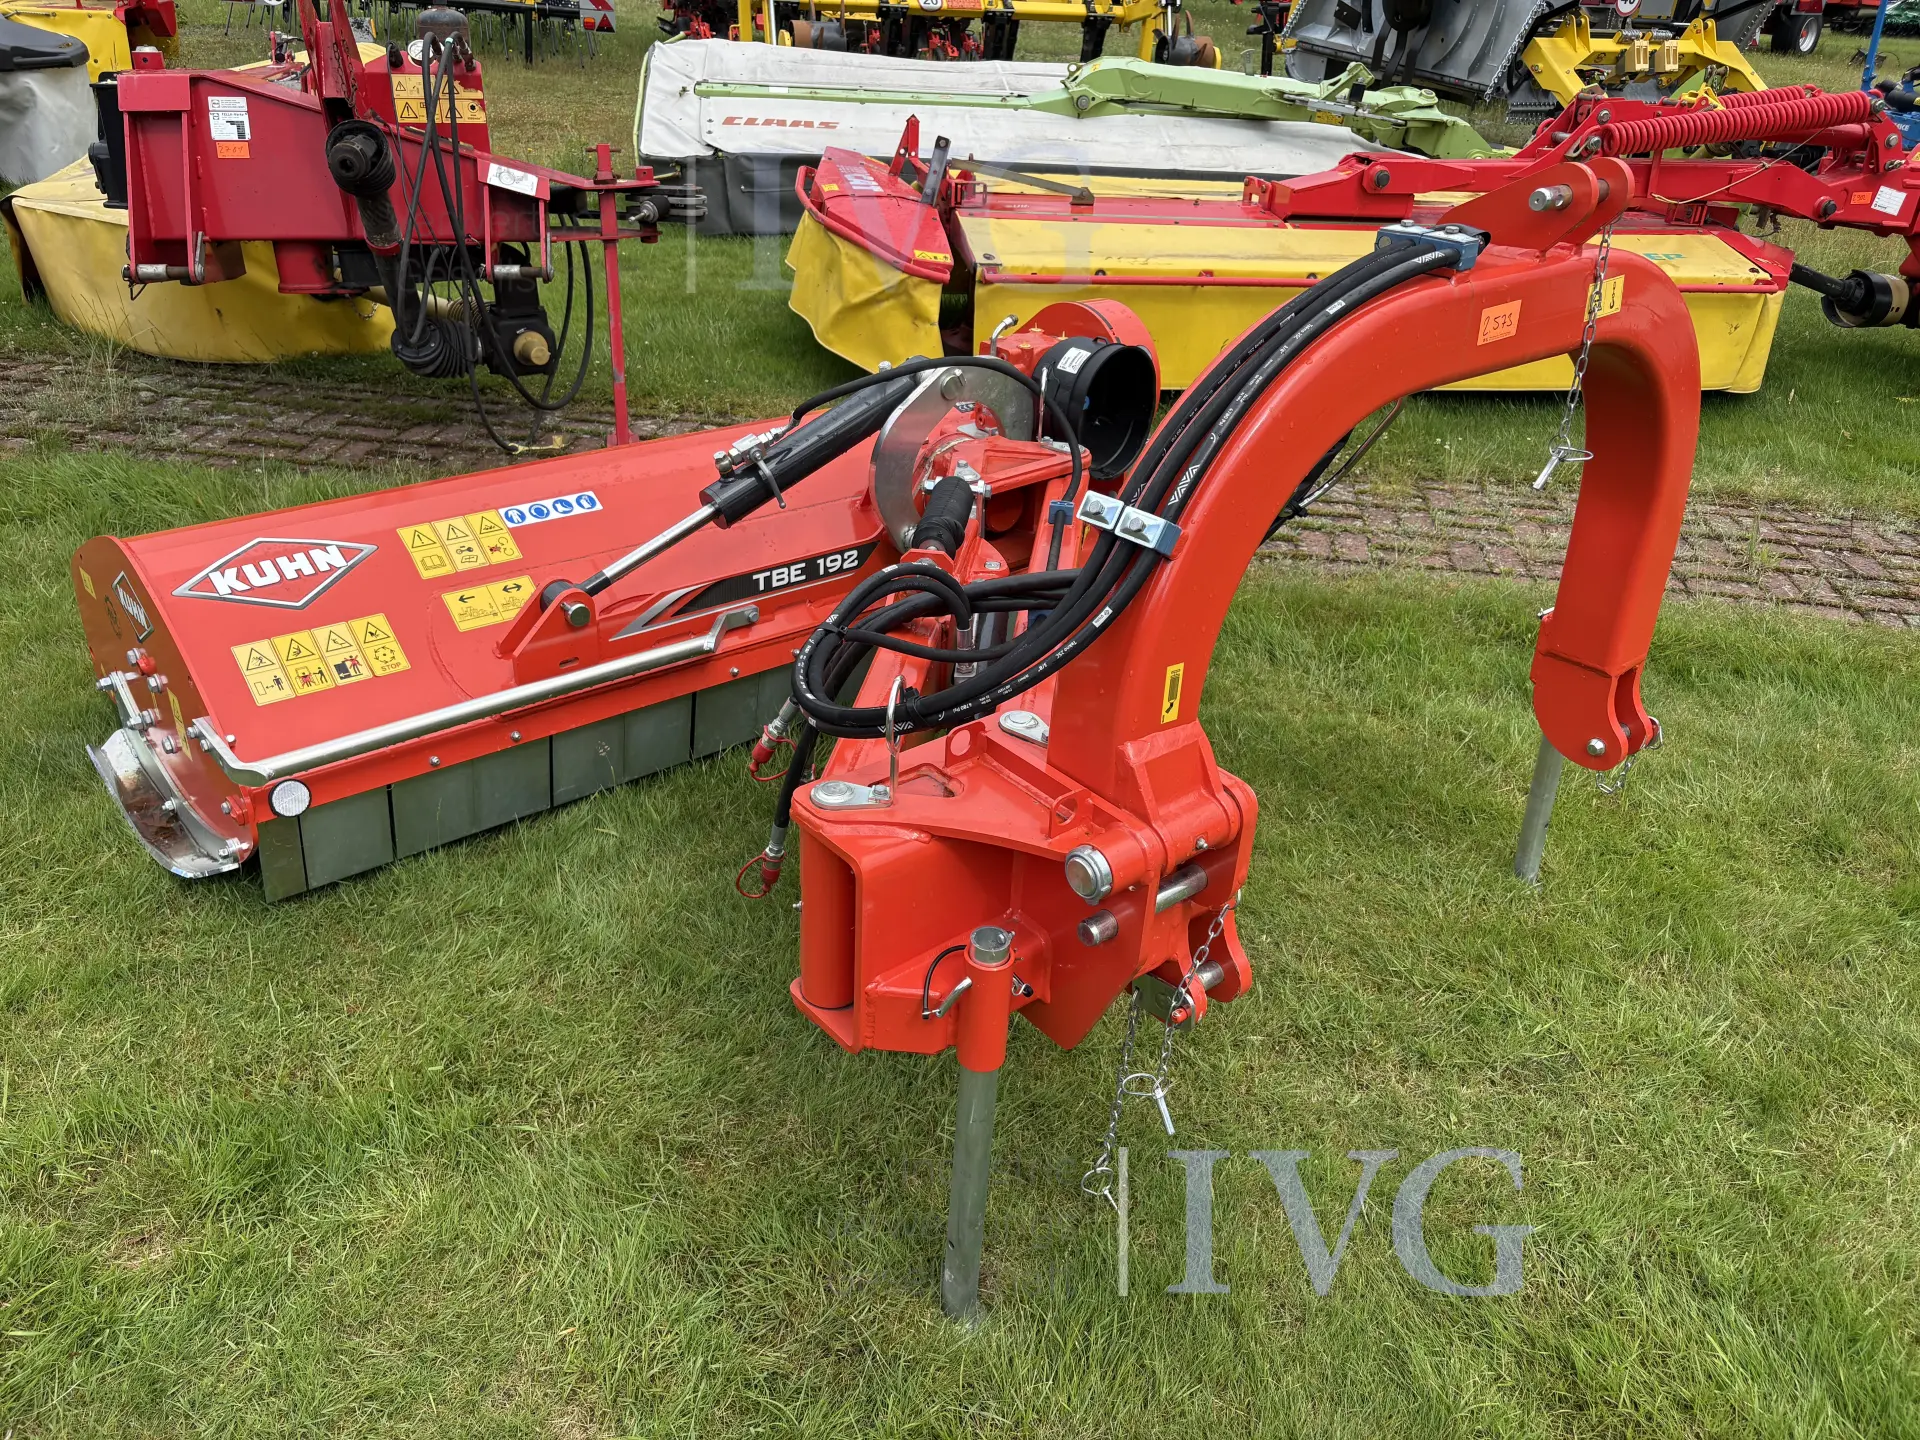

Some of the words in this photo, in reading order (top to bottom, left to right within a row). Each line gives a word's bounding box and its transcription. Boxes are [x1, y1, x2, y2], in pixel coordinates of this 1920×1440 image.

[722, 116, 840, 130] CLAAS
[208, 545, 348, 596] KUHN
[753, 563, 806, 591] TBE
[817, 550, 858, 576] 192
[117, 584, 148, 631] KUHN
[380, 662, 401, 671] STOP
